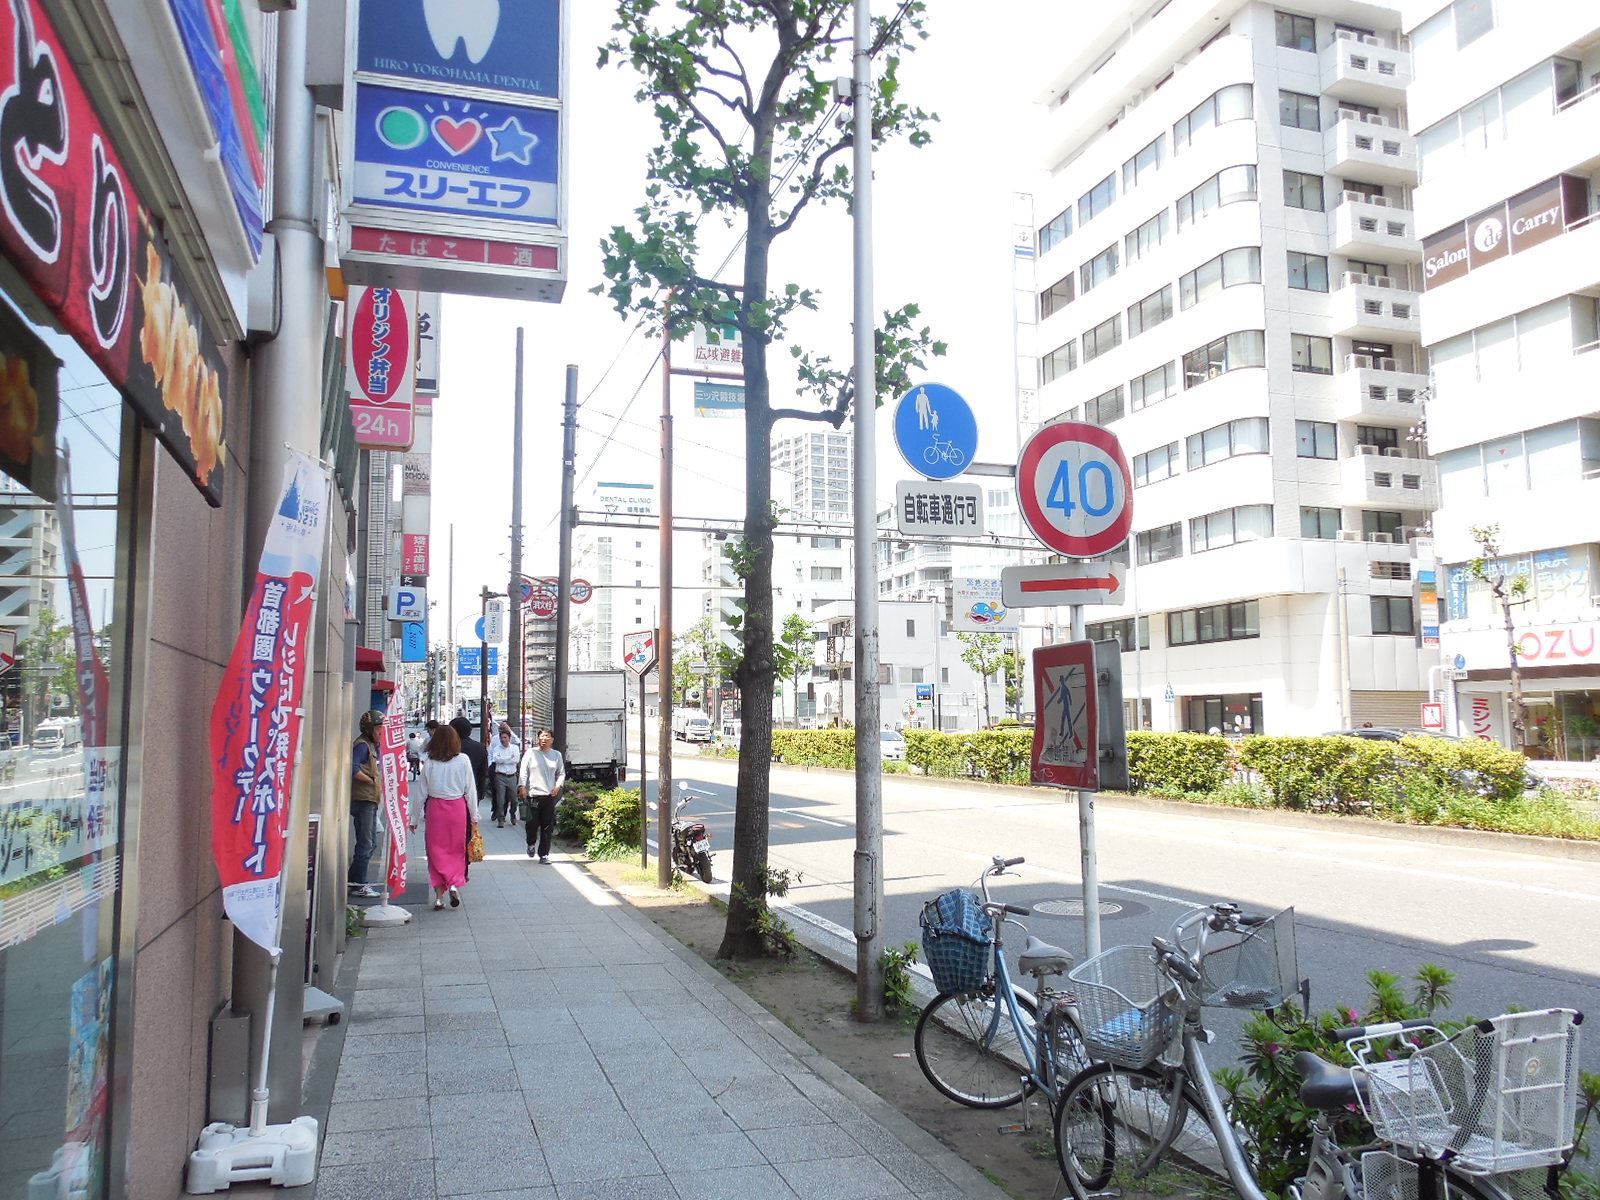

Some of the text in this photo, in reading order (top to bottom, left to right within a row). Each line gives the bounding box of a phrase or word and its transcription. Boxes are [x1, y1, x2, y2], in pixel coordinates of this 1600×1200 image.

[374, 57, 542, 91] HIRO YOKOHAMA DENTAL
[426, 159, 490, 174] CONVENIENCE
[384, 170, 531, 209] スリーエフ
[379, 233, 533, 266] たばこ 酒
[1425, 247, 1468, 278] Salon
[1512, 206, 1560, 236] Carry
[368, 287, 391, 394] オリジン弁当
[356, 412, 399, 437] 24h
[600, 495, 627, 503] DENTAL
[1046, 459, 1115, 517] 40
[904, 492, 977, 526] 自転車通行可
[413, 535, 426, 573] 矯正歯科
[397, 592, 415, 615] P
[533, 600, 553, 610] 消火栓
